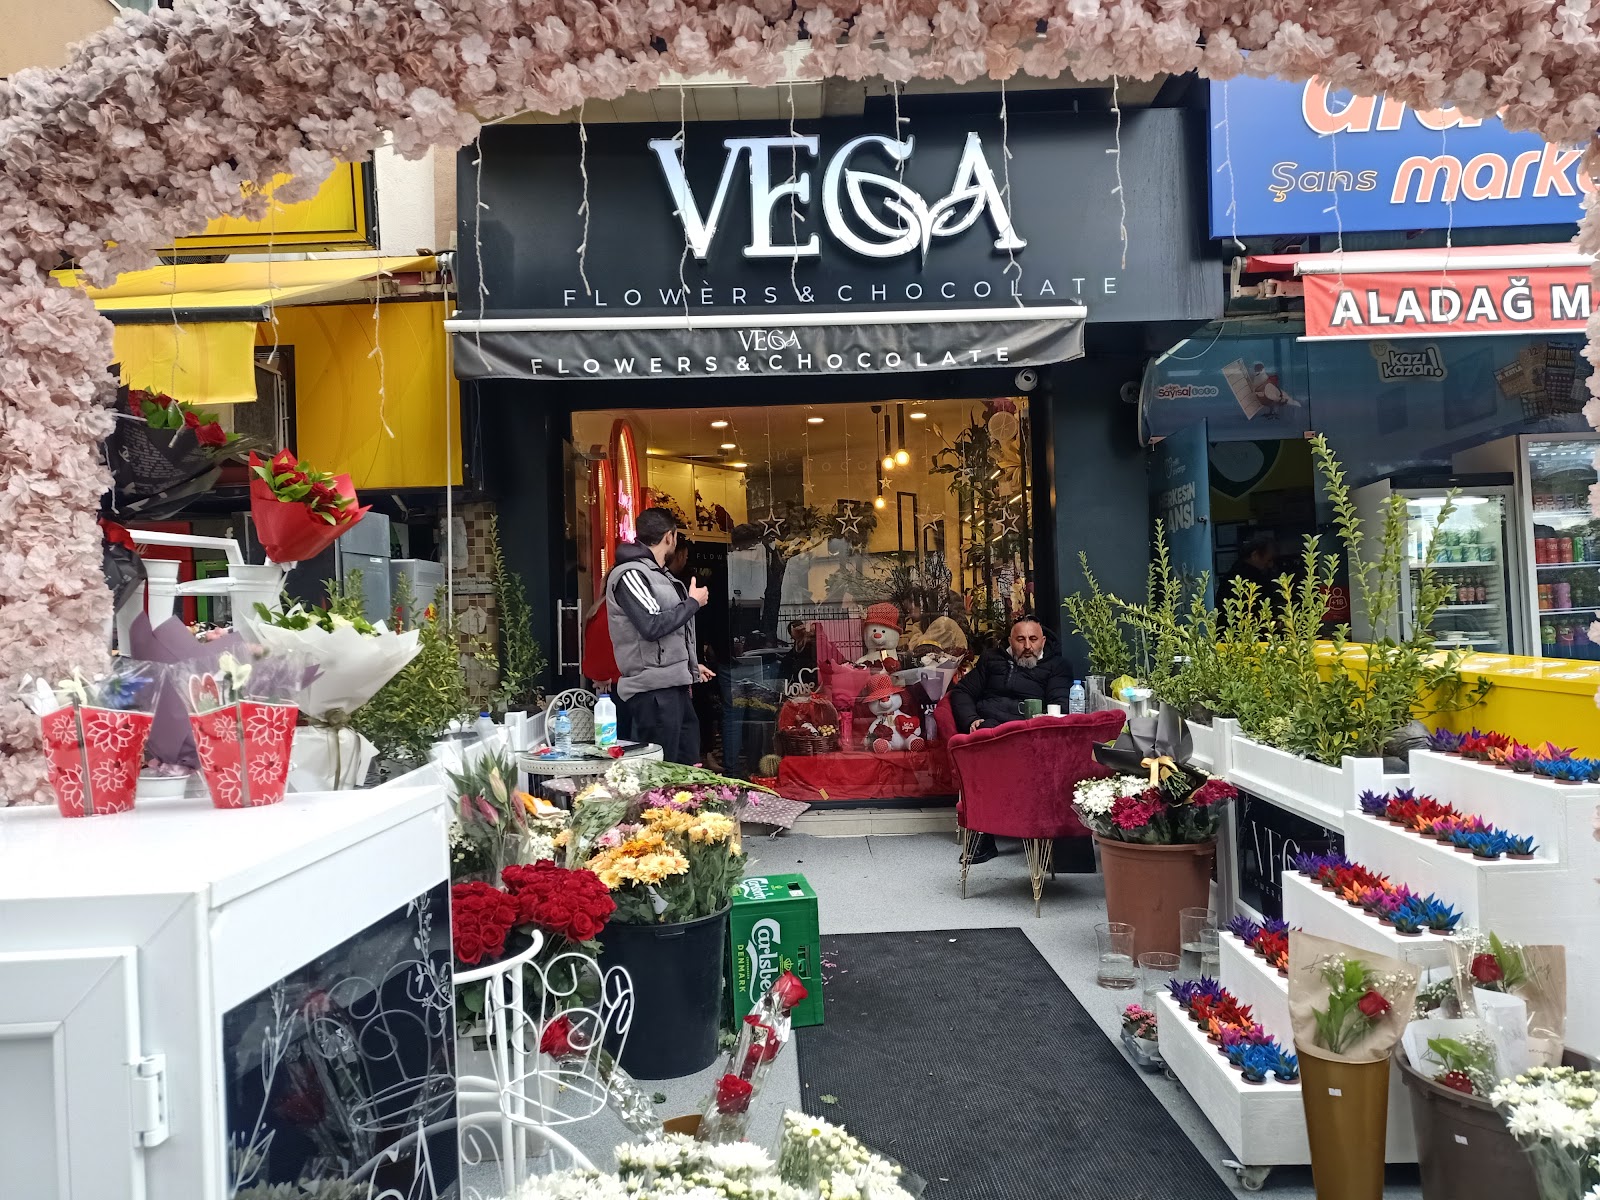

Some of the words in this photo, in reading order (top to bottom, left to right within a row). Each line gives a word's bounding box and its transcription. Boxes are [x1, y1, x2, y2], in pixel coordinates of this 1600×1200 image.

[647, 131, 1027, 266] VEGA
[1268, 161, 1377, 201] Şans
[800, 285, 815, 302] &
[838, 278, 1117, 301] CHOCOLATE
[1330, 276, 1534, 327] ALADAĞ
[1550, 282, 1593, 320] M
[737, 329, 802, 351] VEGA
[531, 356, 718, 374] FLOWERS
[736, 357, 750, 371] &
[769, 347, 1009, 370] CHOCOLATE
[1166, 500, 1195, 533] ANSI
[737, 944, 747, 992] DENMARK
[748, 918, 781, 1001] Carlsbe
